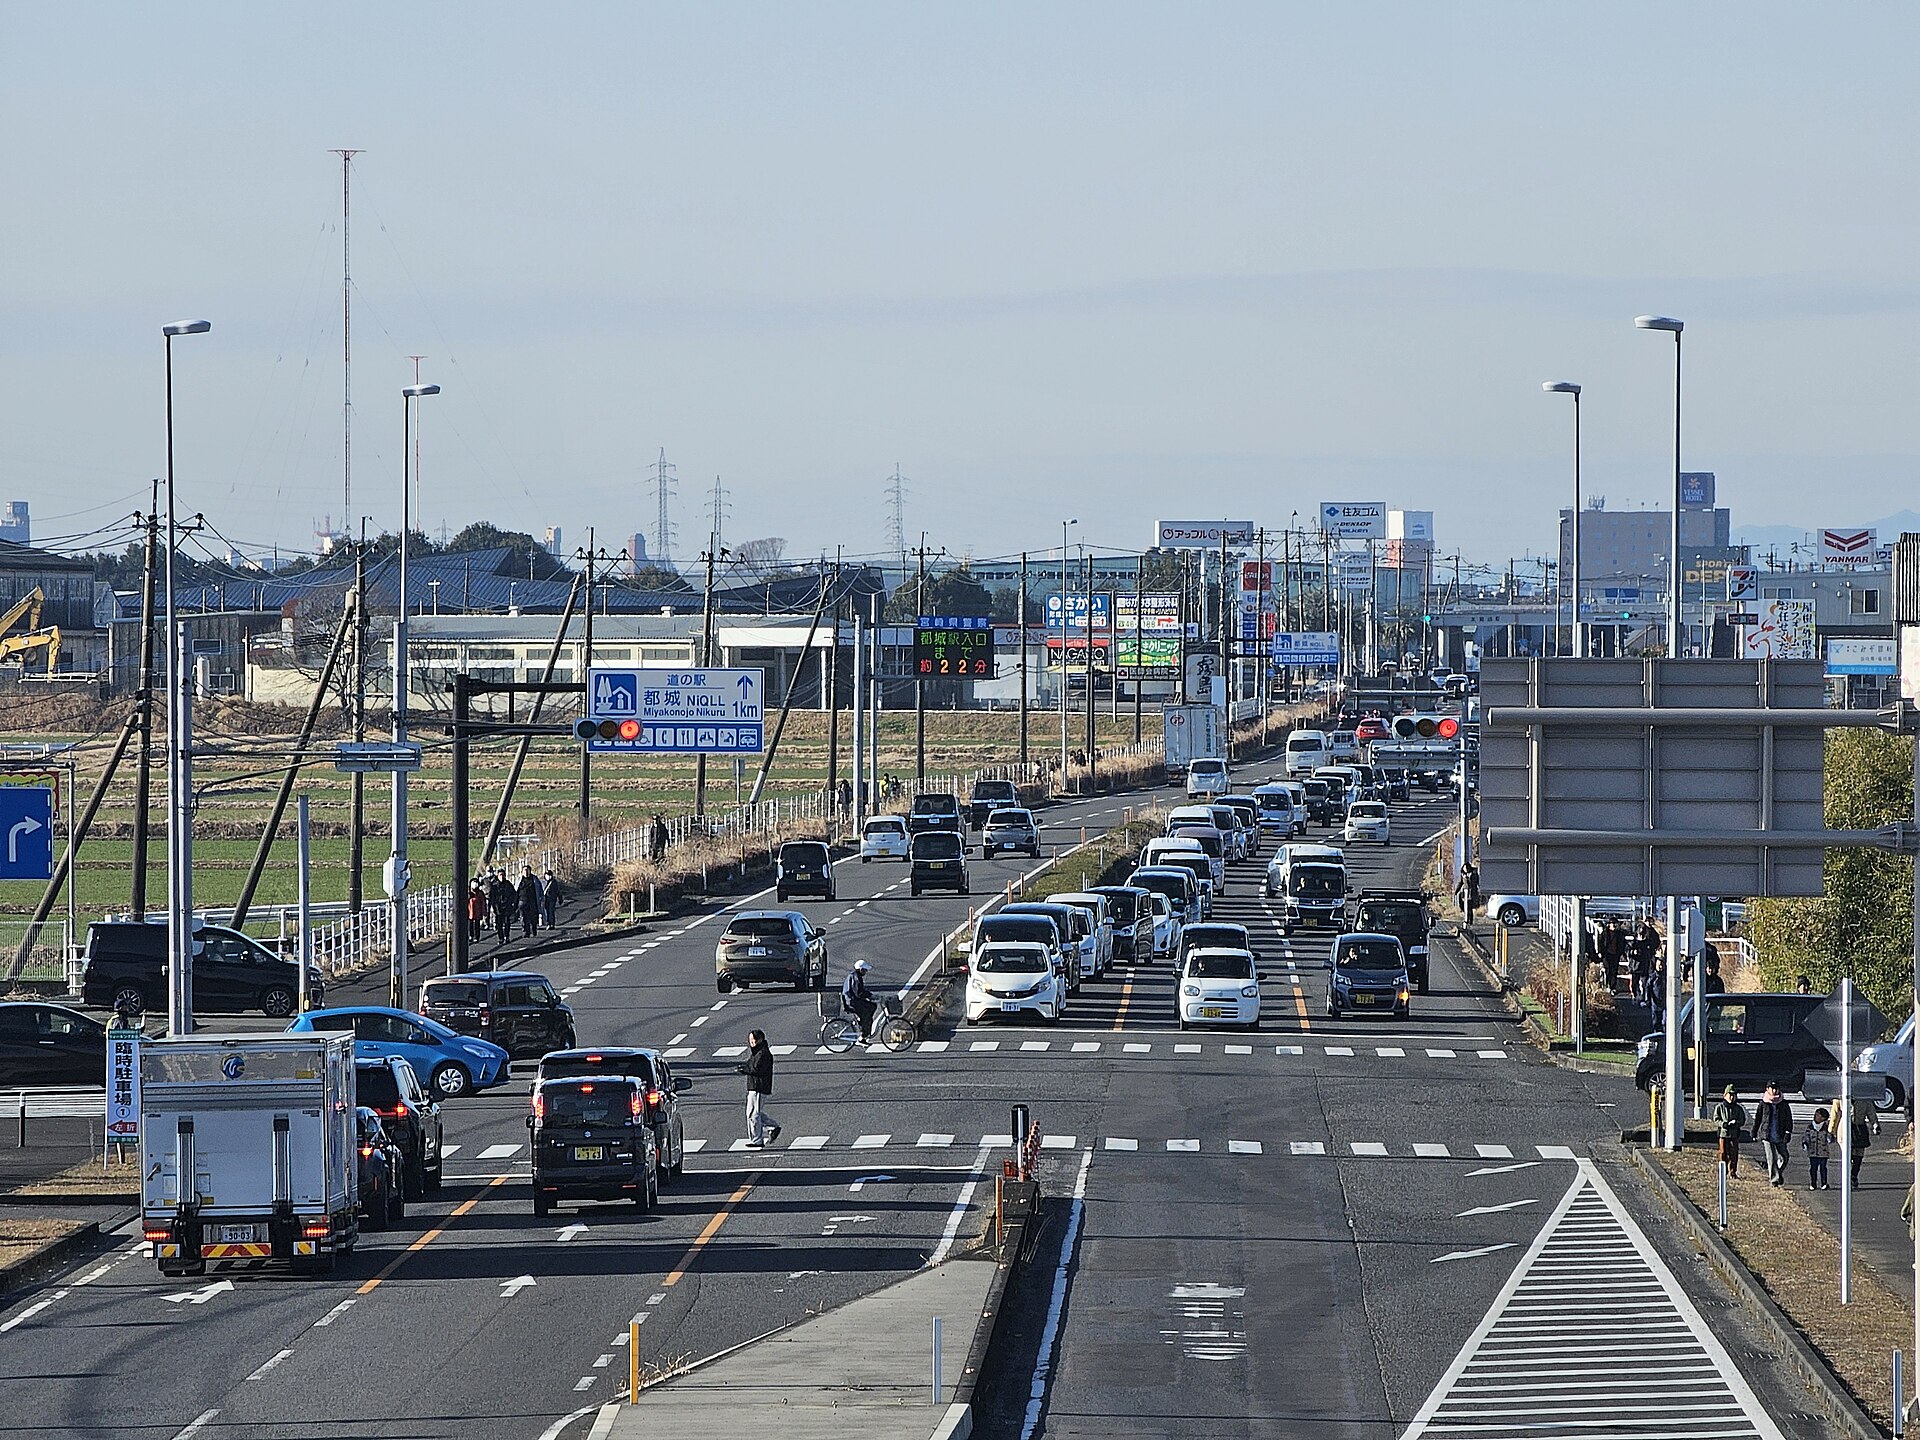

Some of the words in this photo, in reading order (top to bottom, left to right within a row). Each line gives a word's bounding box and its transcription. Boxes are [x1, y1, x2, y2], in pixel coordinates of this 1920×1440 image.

[1342, 507, 1379, 517] 住友ゴム
[920, 617, 987, 627] 宮崎県警察
[921, 631, 987, 645] 都城駅入口
[934, 647, 973, 659] まで
[667, 674, 706, 686] 道の駅
[644, 690, 681, 706] 都城
[687, 695, 726, 706] NiQLL
[643, 707, 694, 718] Miyakonojo
[696, 707, 726, 717] Nikuru
[732, 700, 758, 718] 1km
[114, 1123, 137, 1132] 左折
